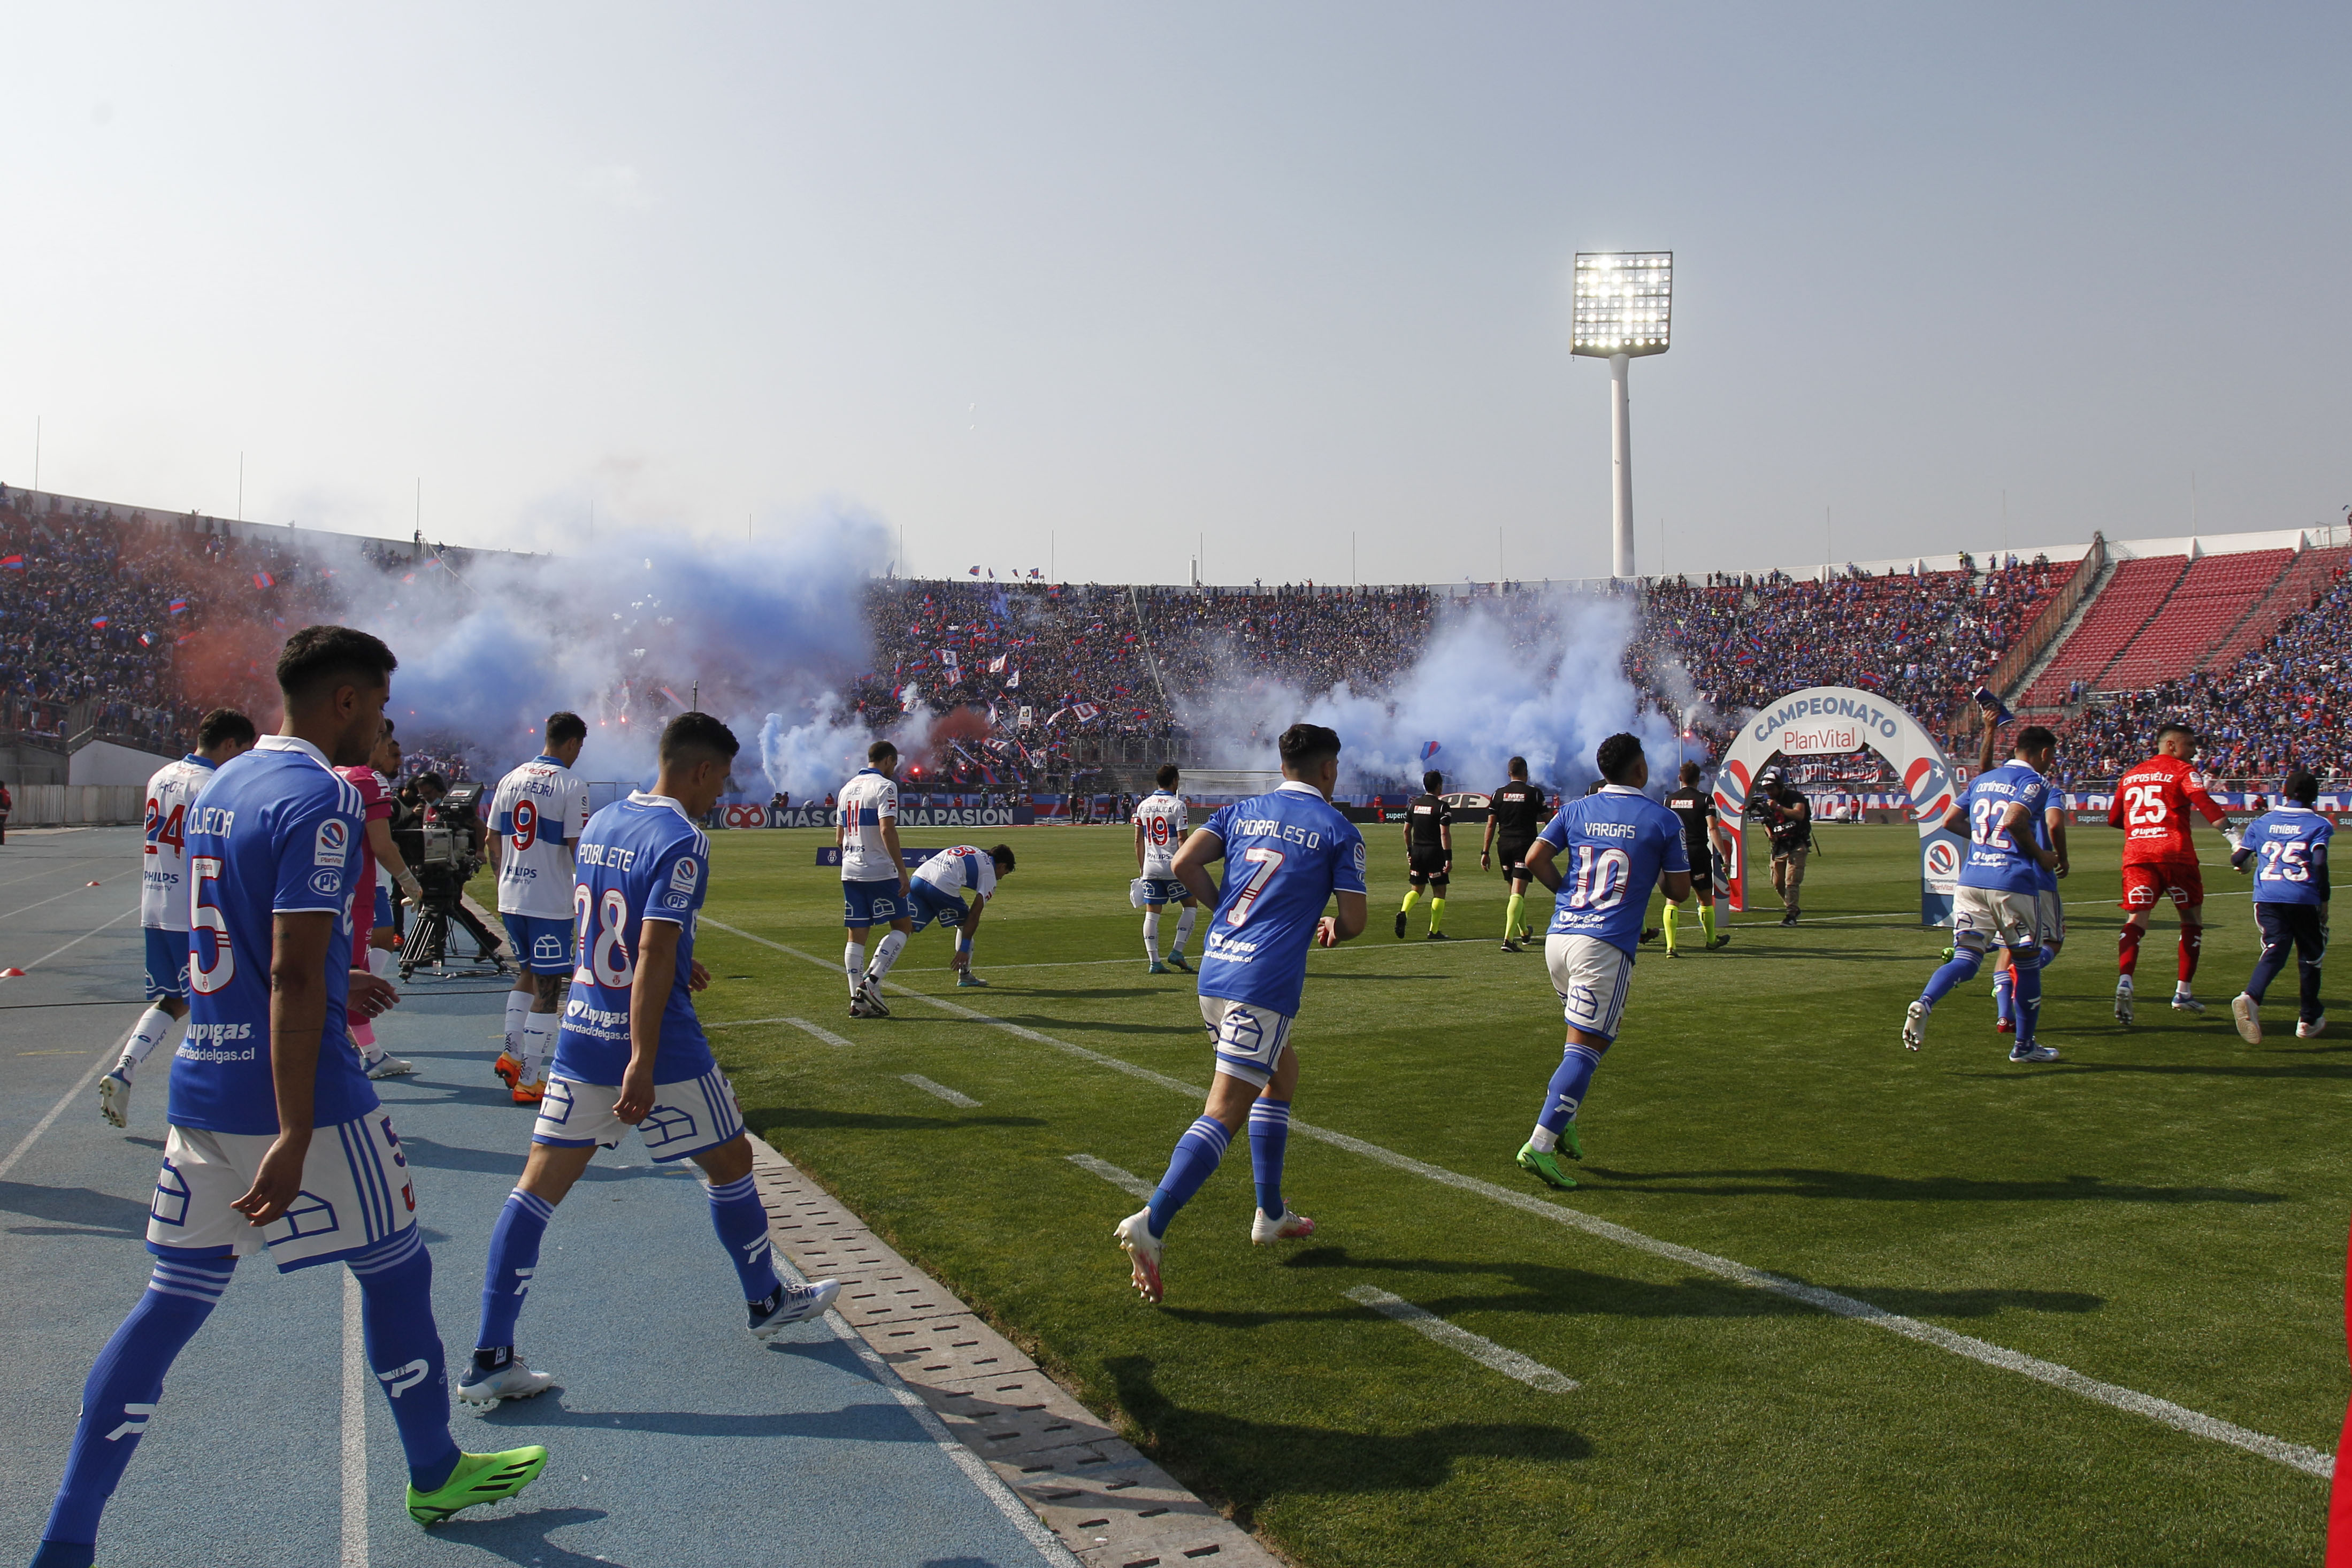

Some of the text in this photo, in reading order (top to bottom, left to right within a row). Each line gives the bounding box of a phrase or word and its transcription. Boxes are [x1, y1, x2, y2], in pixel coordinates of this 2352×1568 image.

[1755, 697, 1897, 742] CAMPEONATO
[1784, 727, 1856, 750] PlanVital
[1976, 780, 2018, 796] DOMÍNGUEZ
[2123, 772, 2174, 786] CAMPOS VÉLIZ
[776, 805, 825, 827] MÁS
[894, 809, 931, 826] NA
[846, 799, 861, 836] 11
[2125, 786, 2167, 826] 25
[146, 797, 186, 859] 24
[189, 806, 235, 839] OJEDA
[511, 800, 539, 852] 9
[1146, 815, 1169, 847] 19
[1235, 818, 1306, 845] MORALES
[1585, 822, 1636, 839] VARGAS
[1971, 798, 2011, 849] 32
[2269, 824, 2303, 834] ANÍBAL
[578, 843, 635, 873] POBLETE
[2259, 841, 2311, 882] 25
[319, 873, 338, 891] PF
[1225, 847, 1286, 928] 7
[1570, 844, 1631, 911] 10
[670, 896, 686, 908] PF
[189, 856, 235, 996] 5
[572, 882, 635, 989] 28
[580, 1003, 629, 1028] Lipigas
